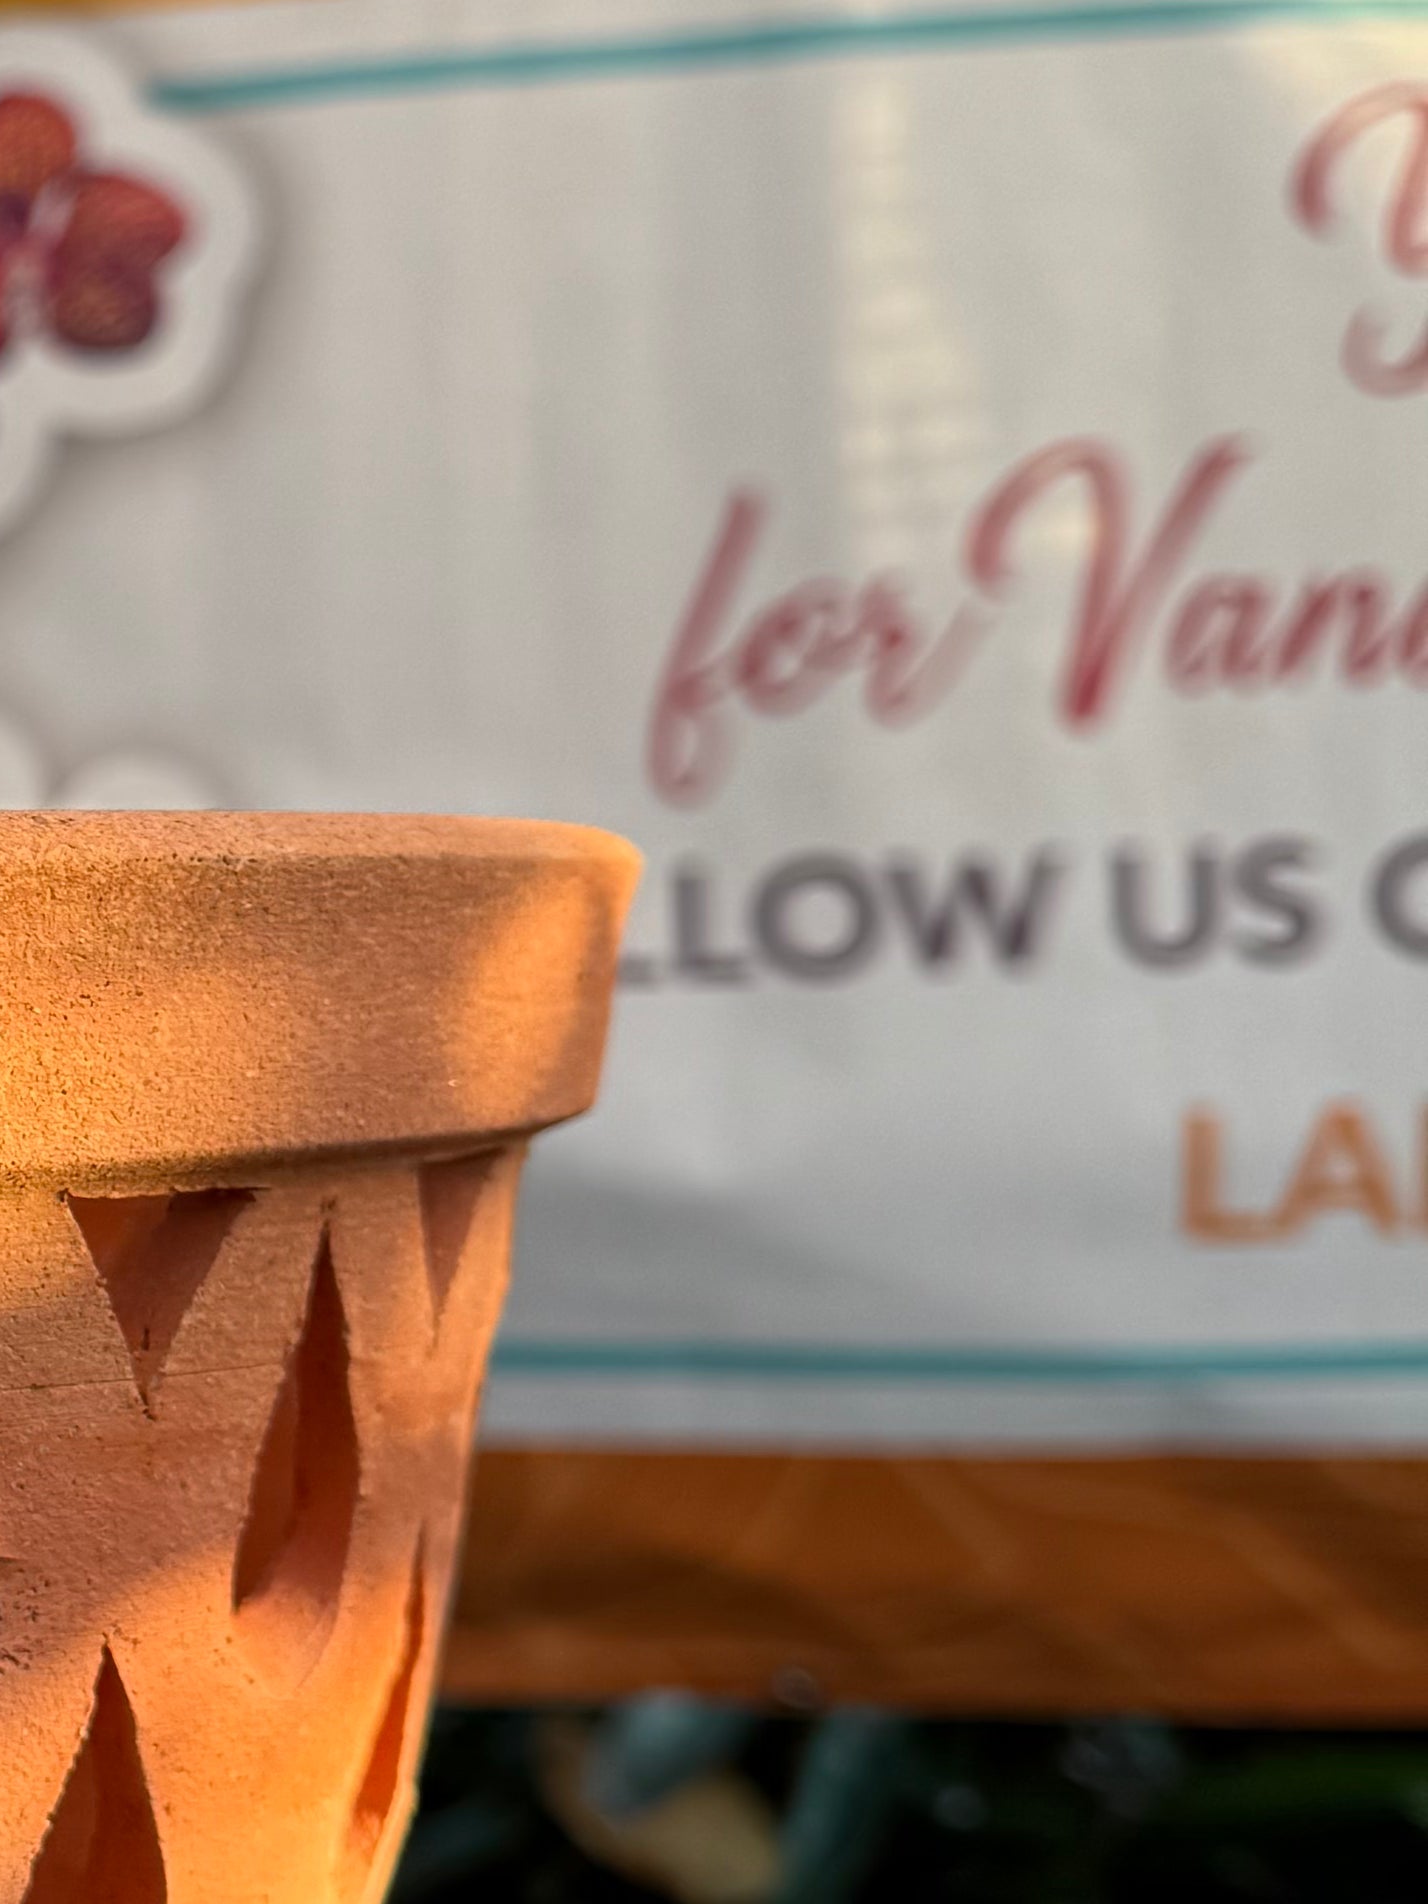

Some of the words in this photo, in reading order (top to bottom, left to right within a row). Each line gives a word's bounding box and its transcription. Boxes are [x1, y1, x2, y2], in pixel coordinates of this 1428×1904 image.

[646, 484, 996, 810] for
[1106, 834, 1324, 976] US
[1179, 1094, 1428, 1251] LA
